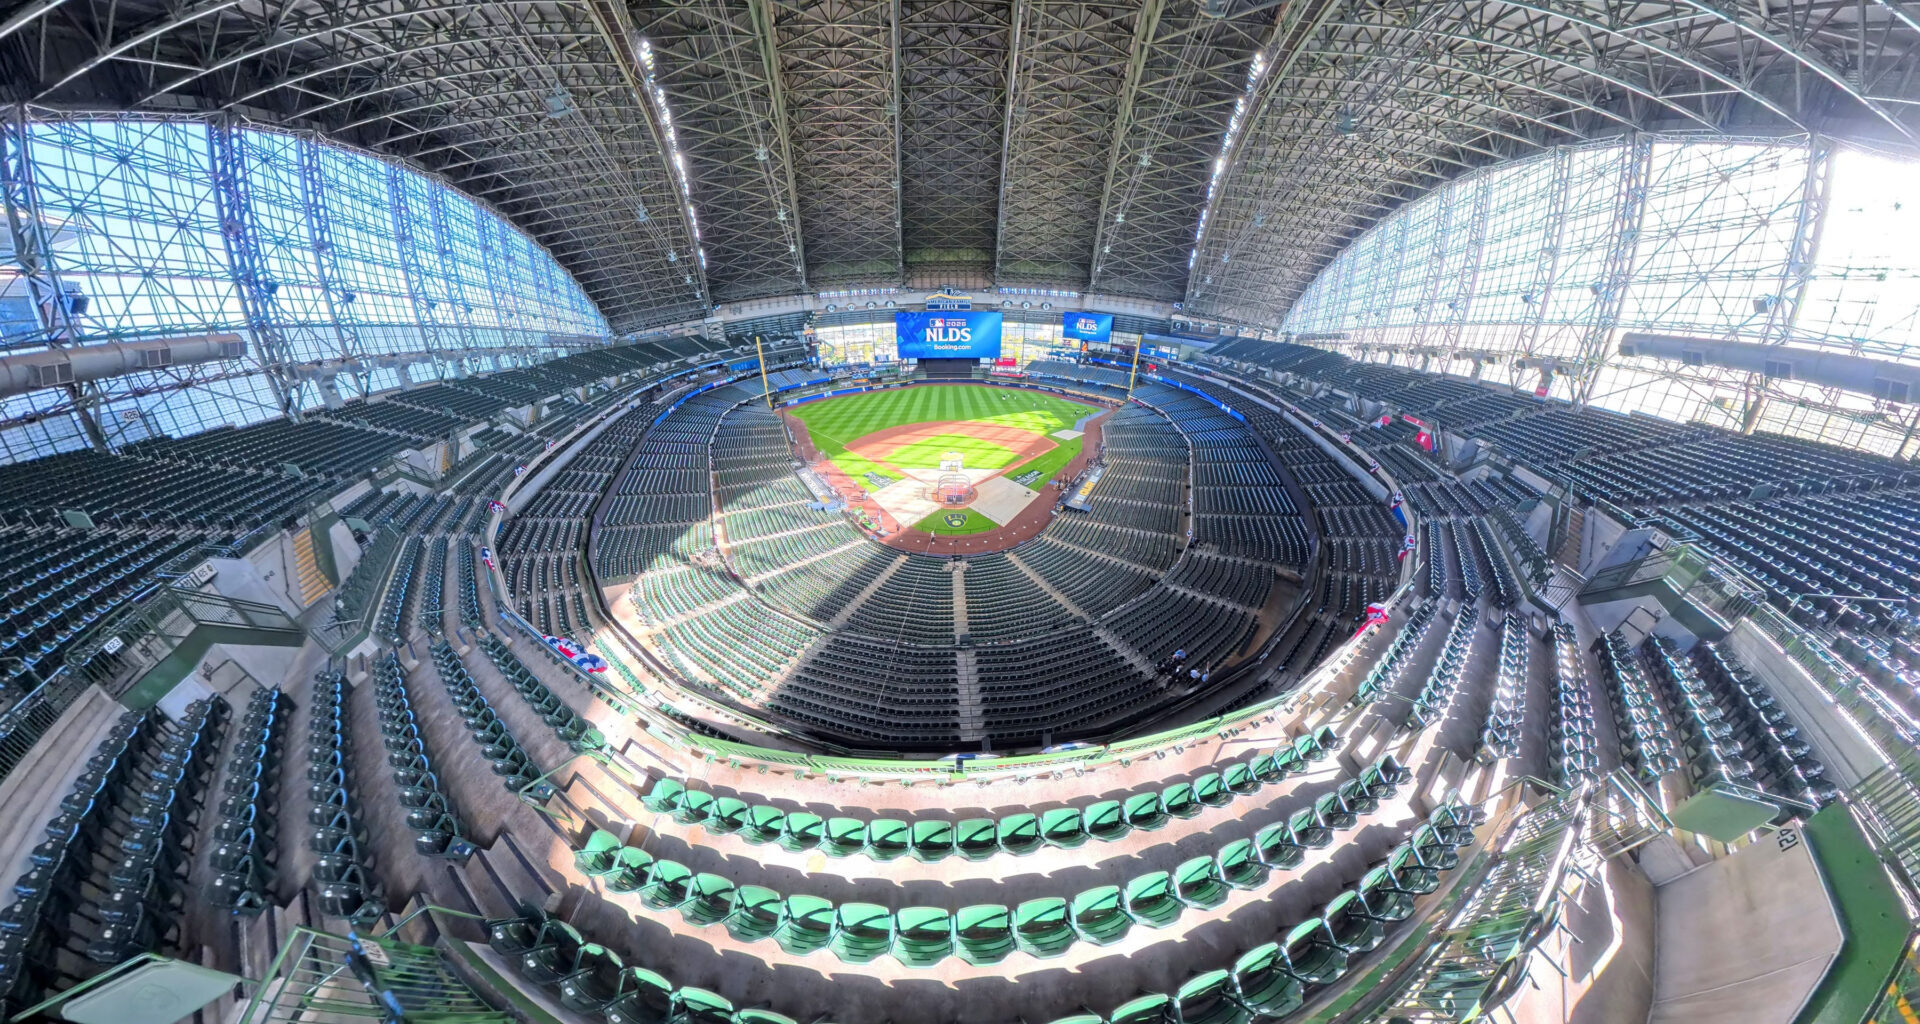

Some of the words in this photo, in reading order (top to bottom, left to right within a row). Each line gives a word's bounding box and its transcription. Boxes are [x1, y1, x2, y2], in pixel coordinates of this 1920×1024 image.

[1076, 322, 1097, 331] NLDS
[925, 328, 971, 342] NLDS
[106, 638, 121, 651] 423
[1776, 828, 1799, 852] 421
